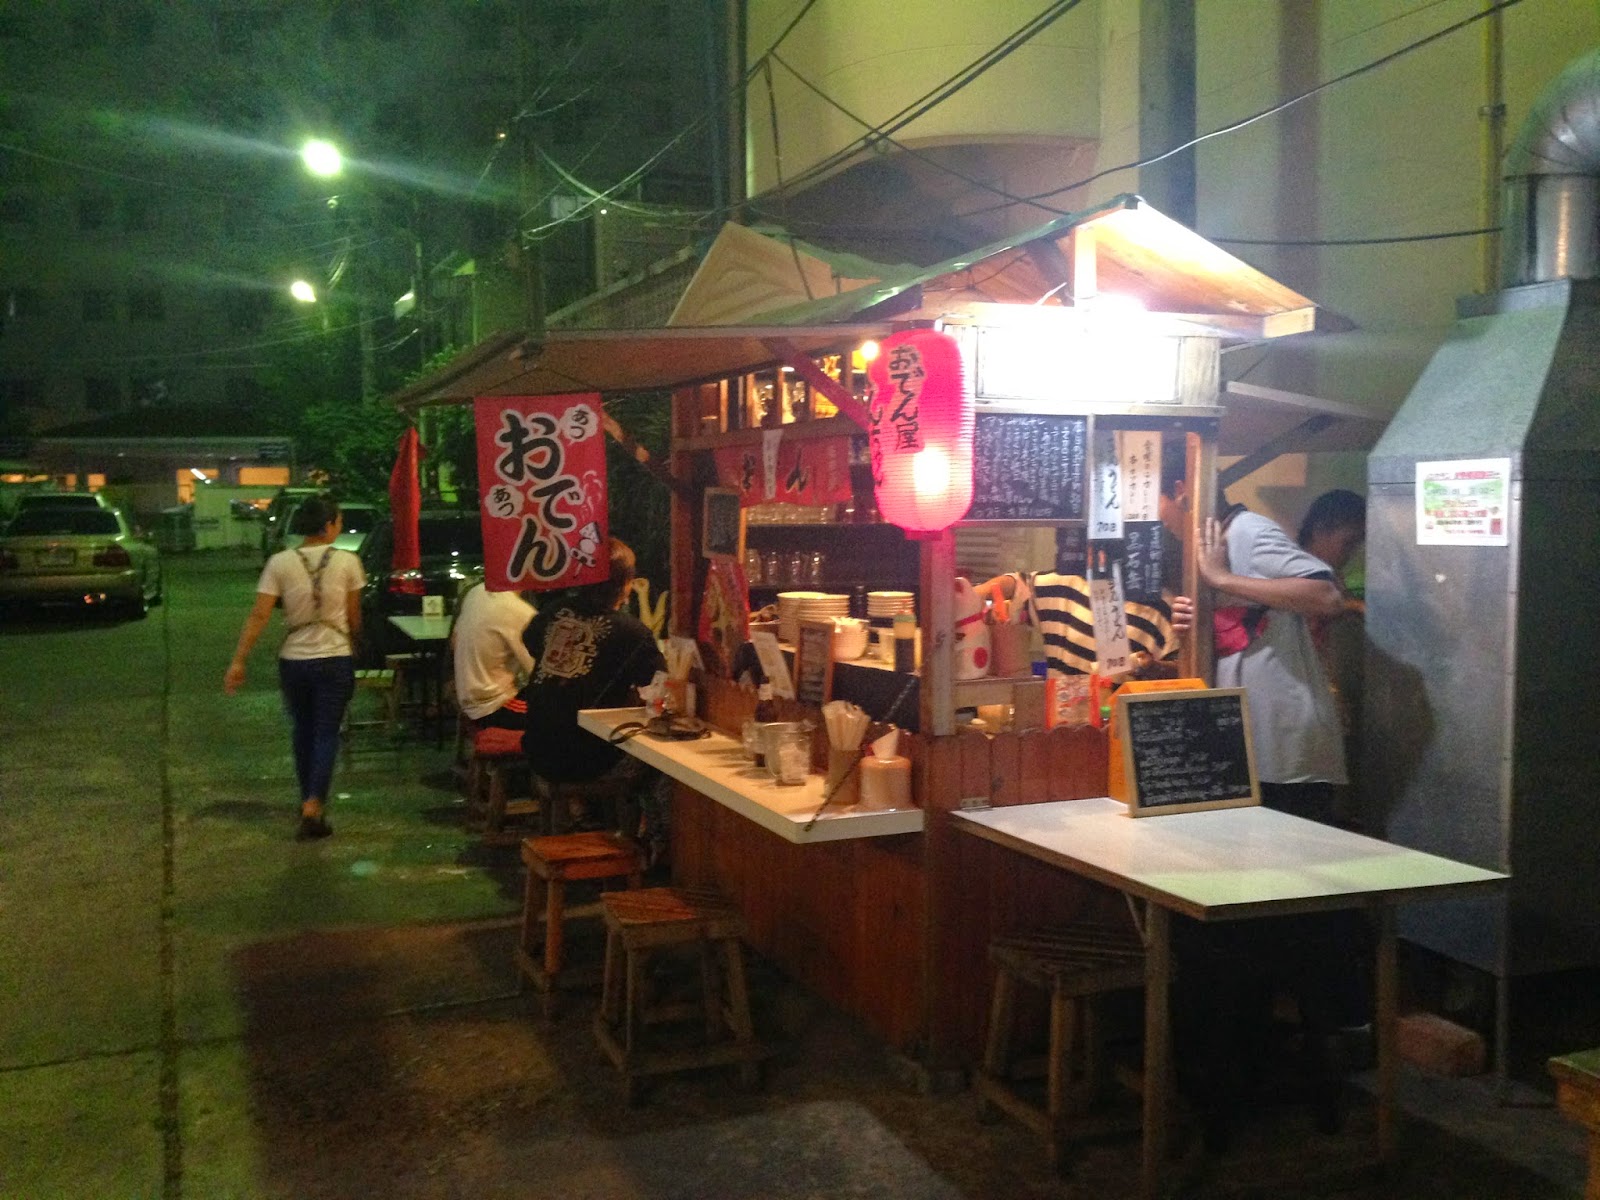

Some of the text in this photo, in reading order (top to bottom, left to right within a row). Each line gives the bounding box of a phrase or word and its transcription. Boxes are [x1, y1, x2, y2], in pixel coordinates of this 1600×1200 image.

[570, 408, 590, 440] あつ
[888, 346, 925, 451] おでん屋
[492, 487, 516, 517] あつ
[498, 410, 582, 580] おでん
